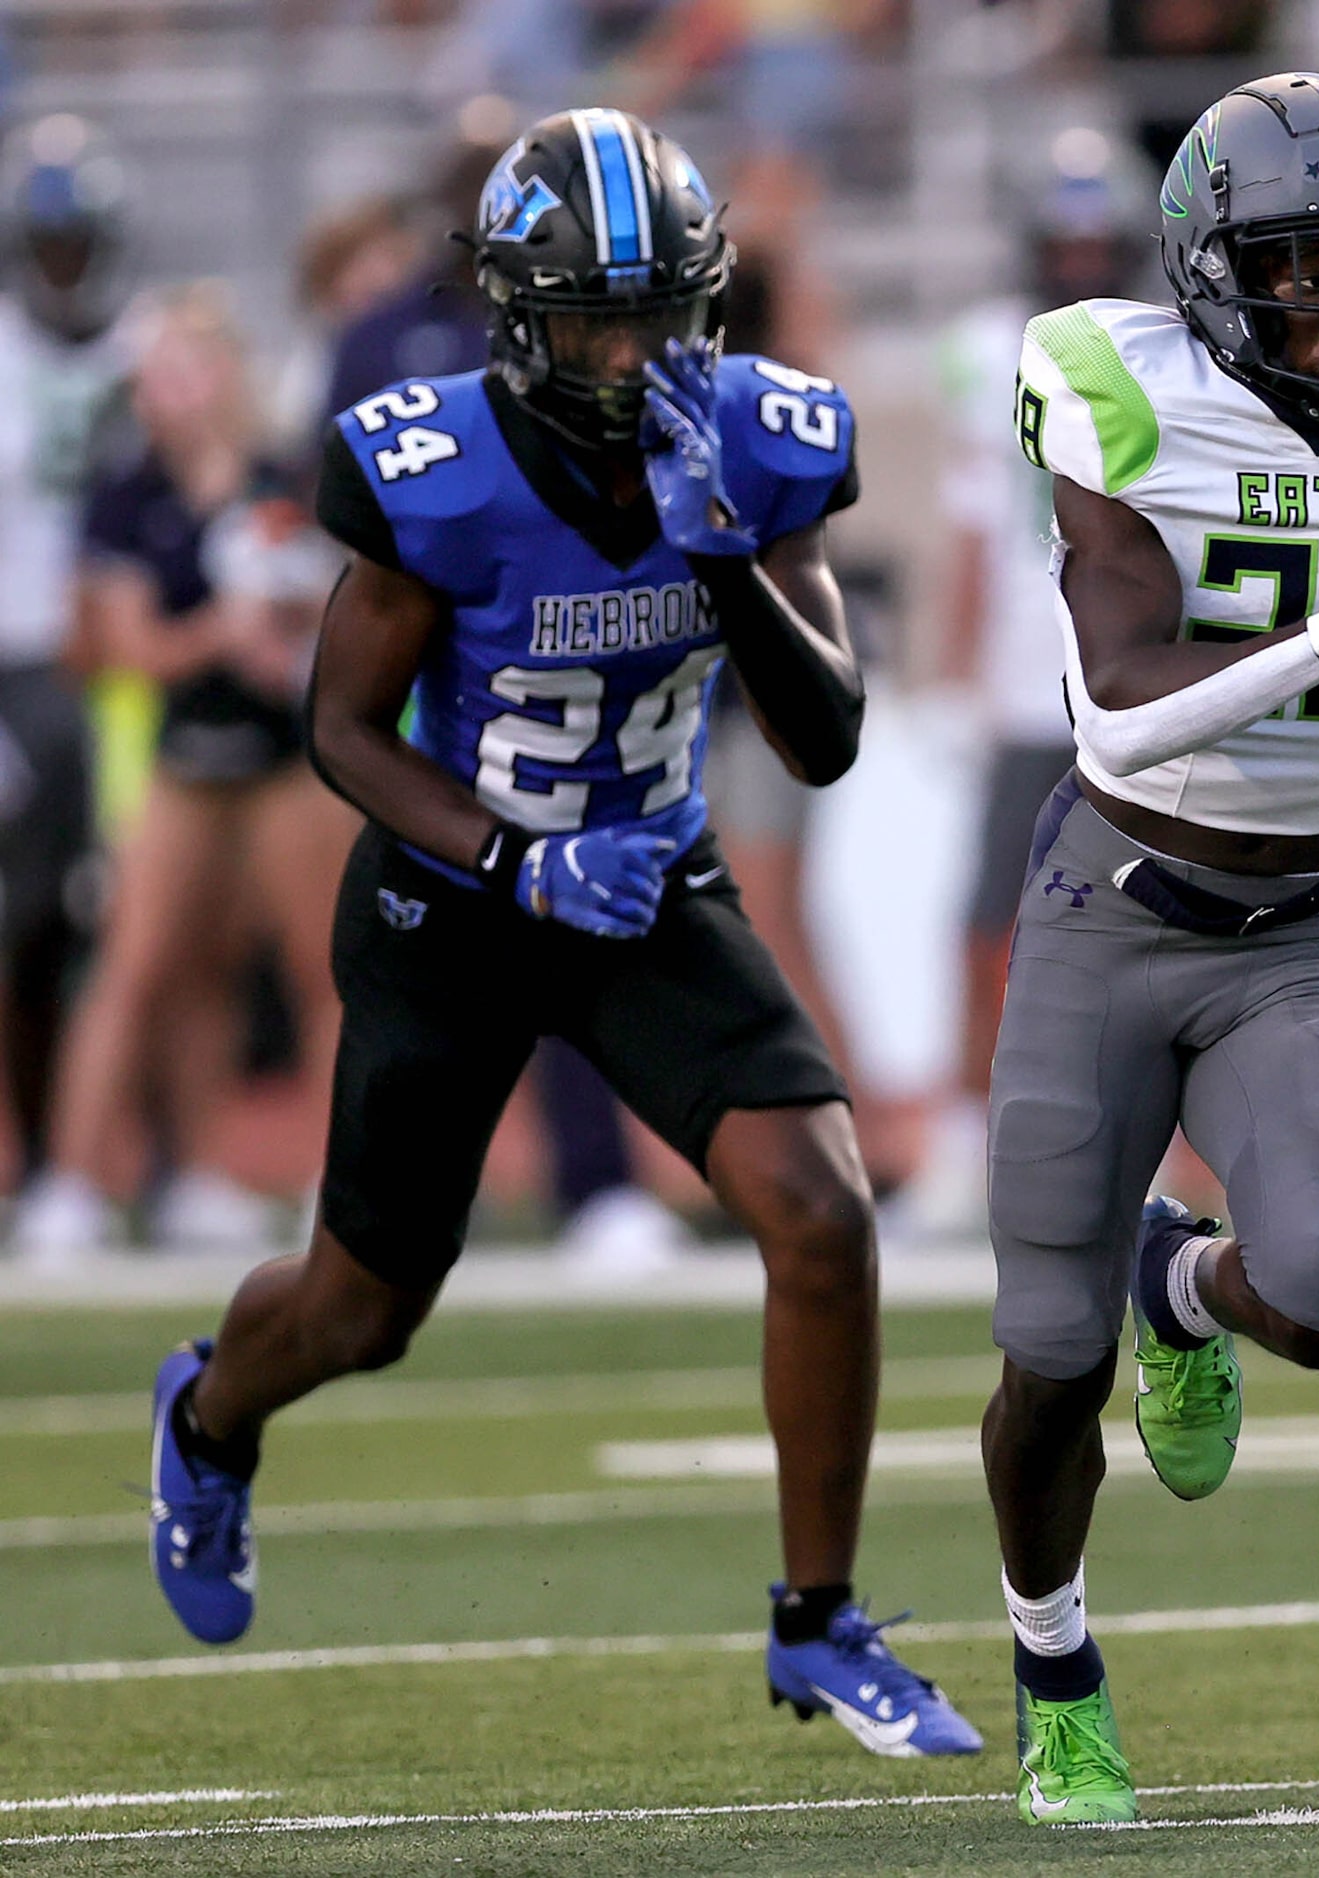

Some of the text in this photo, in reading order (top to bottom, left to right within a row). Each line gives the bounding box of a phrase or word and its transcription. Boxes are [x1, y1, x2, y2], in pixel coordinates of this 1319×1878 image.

[352, 383, 460, 483] 24
[1014, 368, 1049, 471] 8
[529, 578, 718, 657] HEBRON
[474, 643, 729, 833] 24
